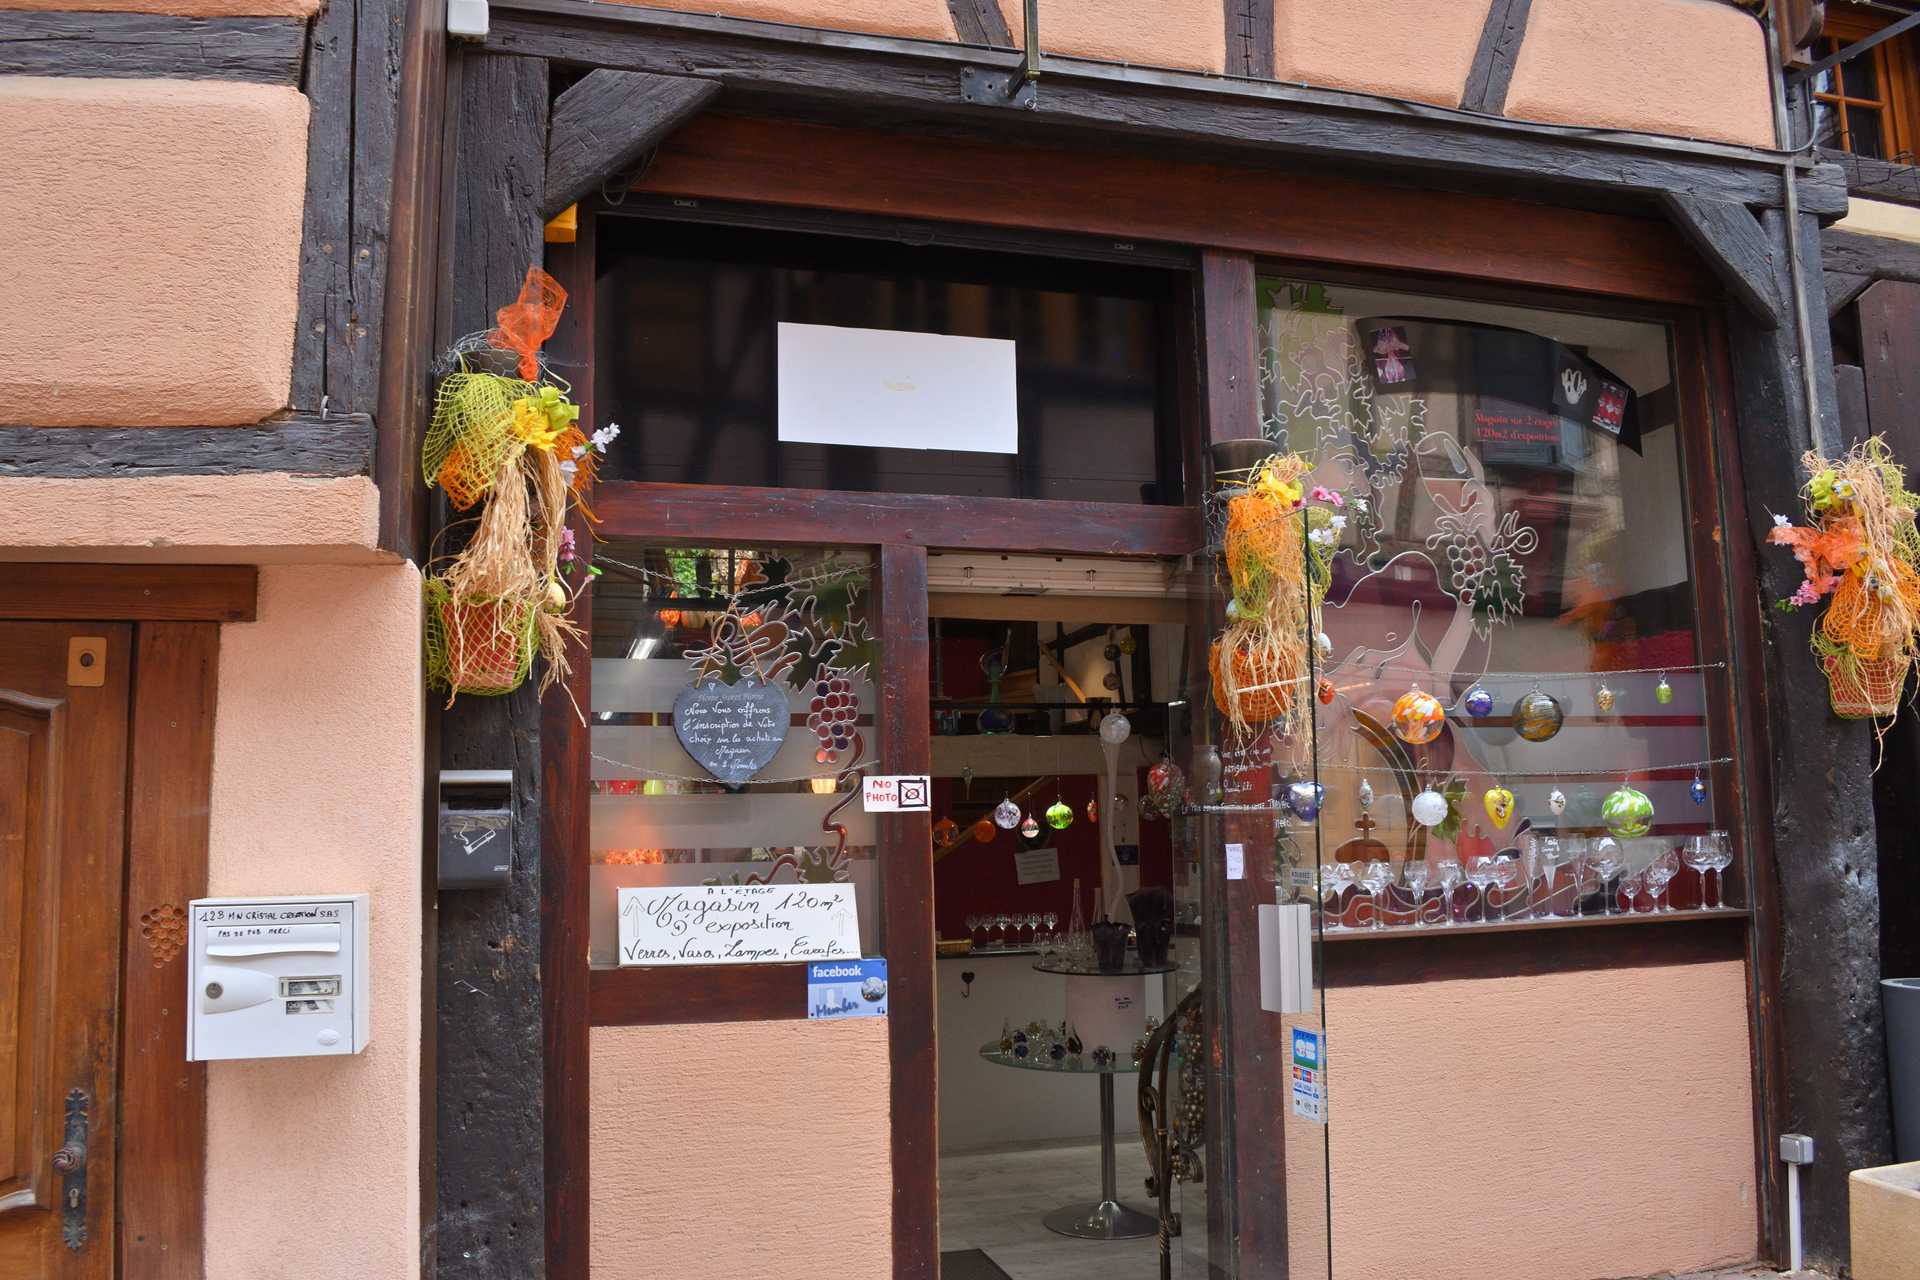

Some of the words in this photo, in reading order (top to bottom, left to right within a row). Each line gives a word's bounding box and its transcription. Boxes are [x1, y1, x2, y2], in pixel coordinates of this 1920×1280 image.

[684, 703, 708, 716] Nous
[738, 702, 771, 719] offrons
[743, 720, 753, 728] de
[872, 780, 892, 789] NO
[866, 791, 898, 803] PHOTO
[647, 892, 760, 930] Magasin
[268, 927, 291, 935] MERCI
[813, 964, 862, 978] facebook
